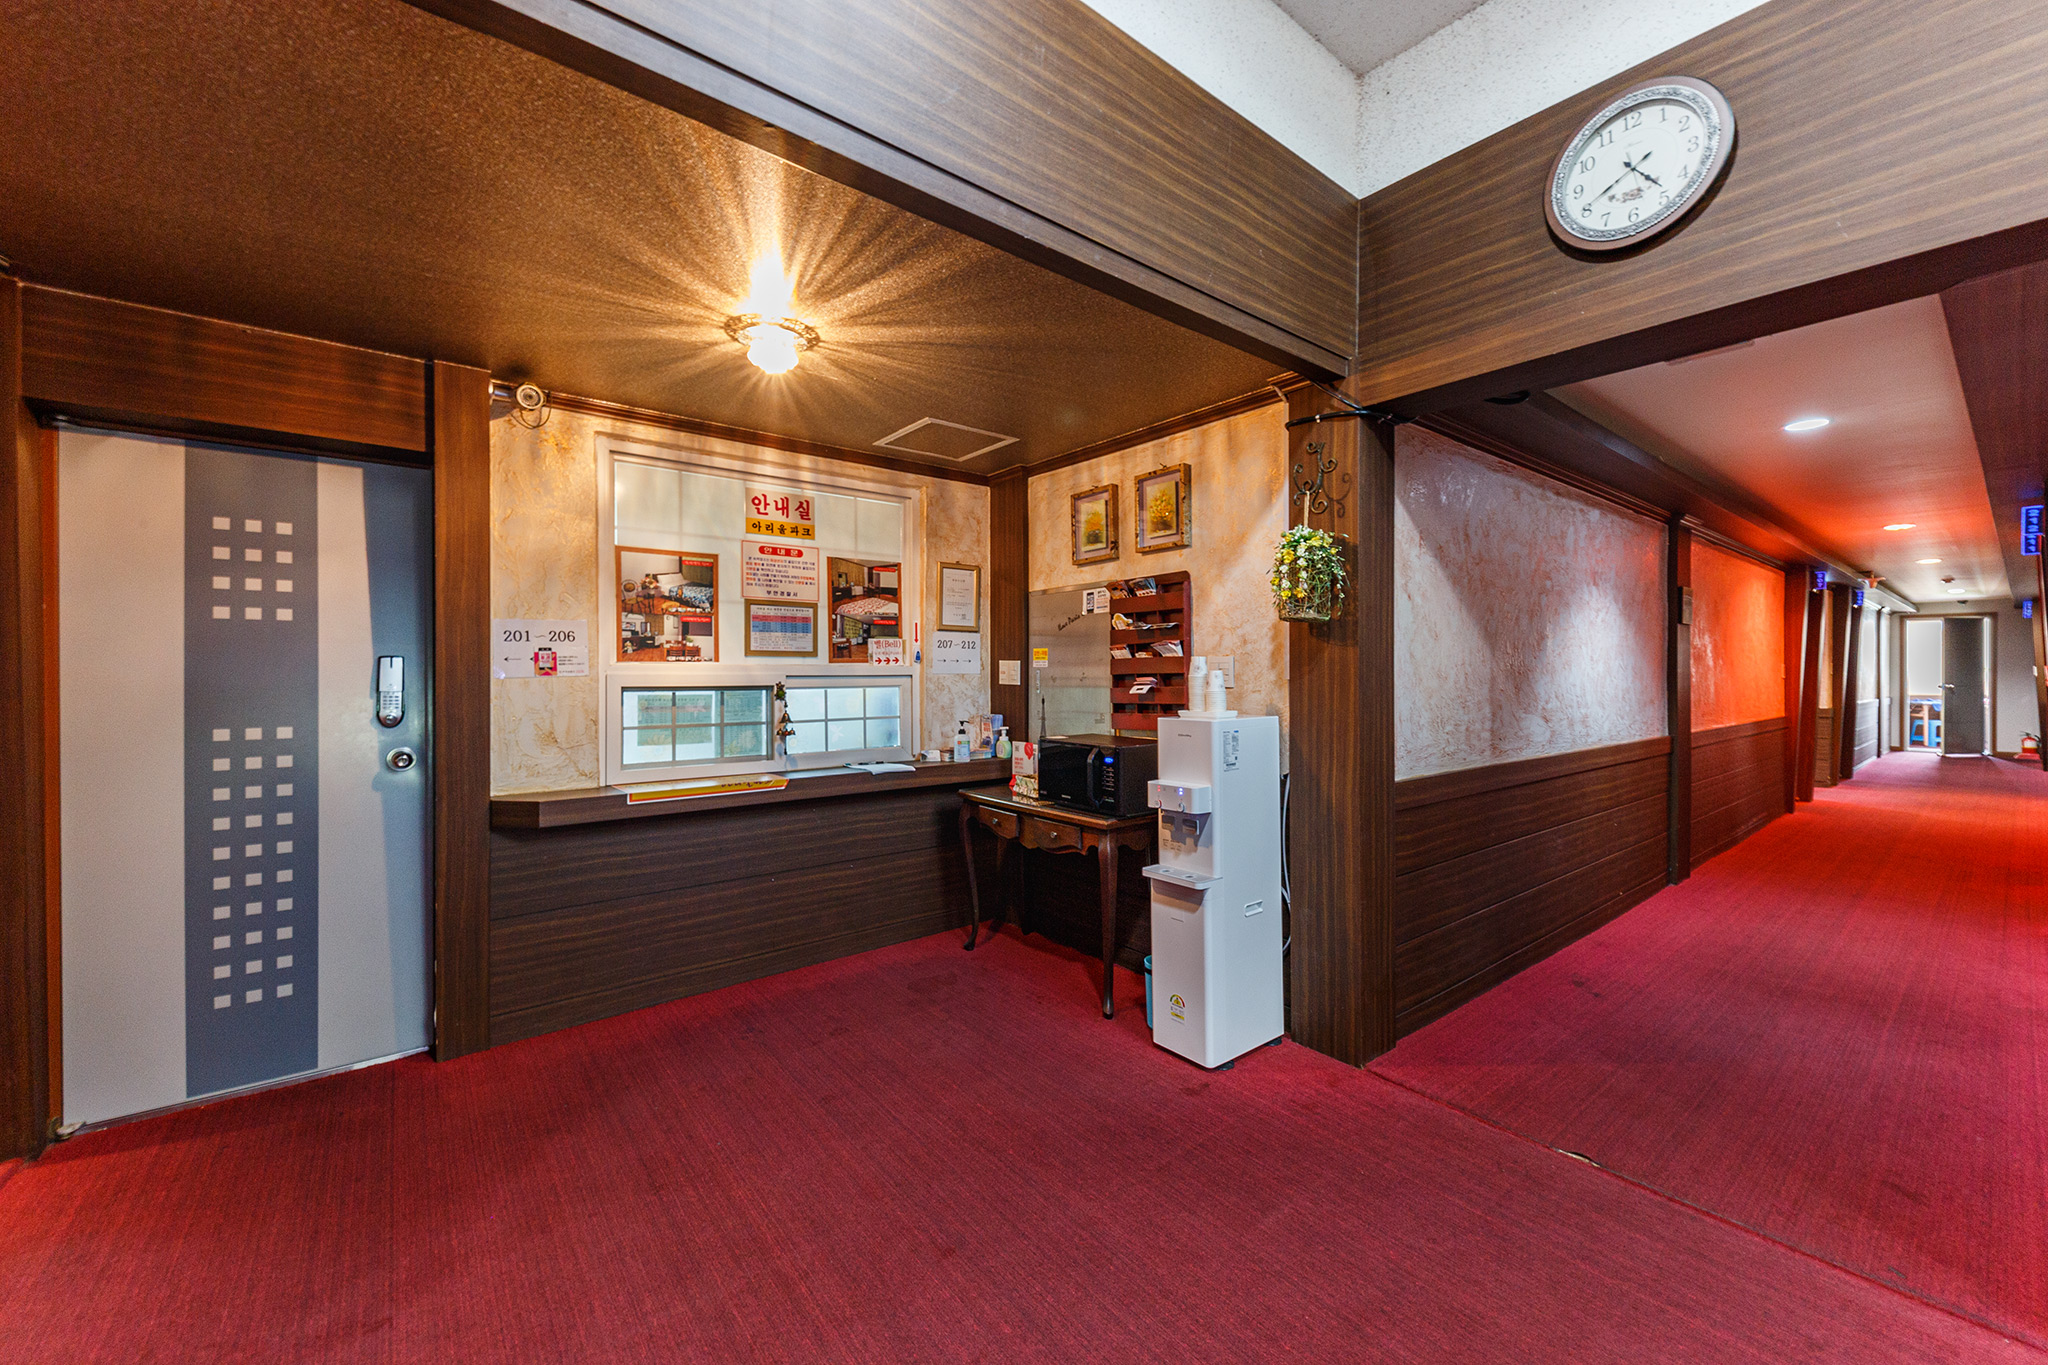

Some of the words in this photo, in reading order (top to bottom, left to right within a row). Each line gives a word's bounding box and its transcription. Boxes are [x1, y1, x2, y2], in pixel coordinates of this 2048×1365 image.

[1622, 111, 1642, 133] 12
[1659, 107, 1668, 123] 1
[1678, 115, 1691, 133] 2
[1597, 130, 1615, 149] 11
[1687, 135, 1700, 153] 3
[1578, 156, 1596, 175] 10
[1677, 164, 1690, 180] 4
[1573, 184, 1584, 200] 9
[1658, 190, 1670, 207] 5
[1581, 203, 1593, 218] 8
[1628, 207, 1640, 223] 6
[1600, 212, 1611, 228] 7
[751, 493, 811, 521] 안내실
[751, 521, 812, 537] 아리울파크
